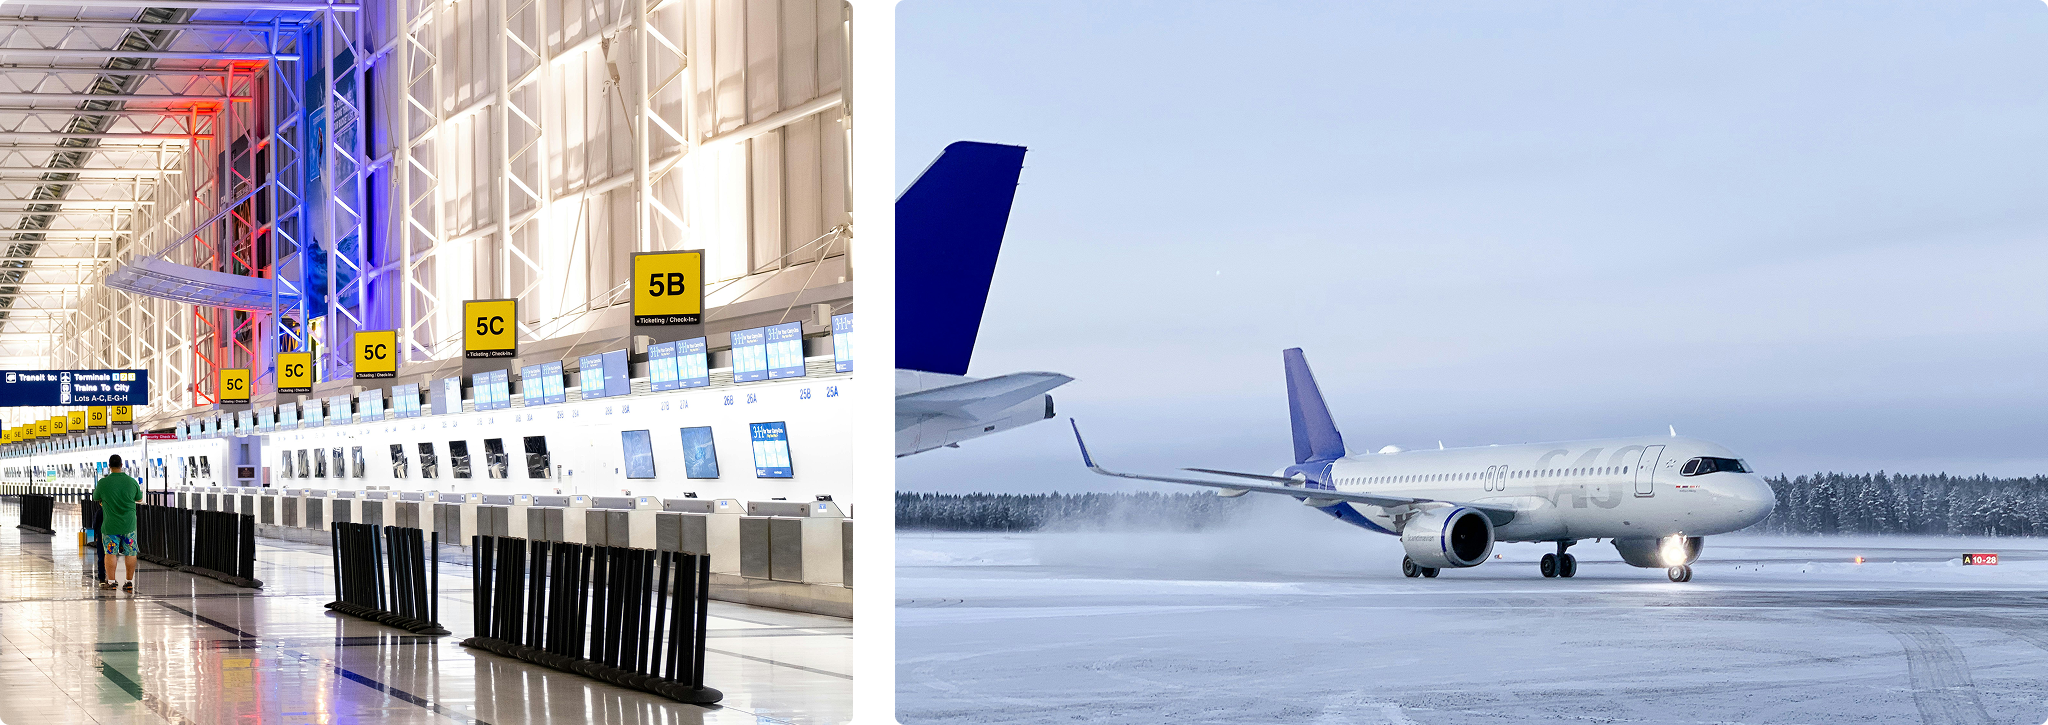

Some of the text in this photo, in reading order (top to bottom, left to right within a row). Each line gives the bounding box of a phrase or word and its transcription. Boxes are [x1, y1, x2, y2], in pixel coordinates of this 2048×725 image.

[649, 272, 685, 297] 5B
[476, 316, 505, 336] 5C
[640, 317, 665, 325] Ticketing
[364, 344, 386, 360] 5C
[74, 371, 110, 381] Terminals
[285, 363, 304, 378] 5C
[19, 373, 57, 382] Transit to:
[74, 383, 130, 393] Trains To City
[226, 378, 243, 390] 5C
[800, 388, 811, 400] 25B
[826, 385, 839, 398] 25A
[723, 394, 734, 406] 26B
[747, 393, 757, 404] 26A
[680, 399, 689, 410] 27A
[91, 412, 103, 420] 5D
[116, 406, 128, 415] 5D
[54, 421, 63, 429] 5D
[71, 416, 81, 425] 5D
[1964, 556, 1997, 564] A 10-28
